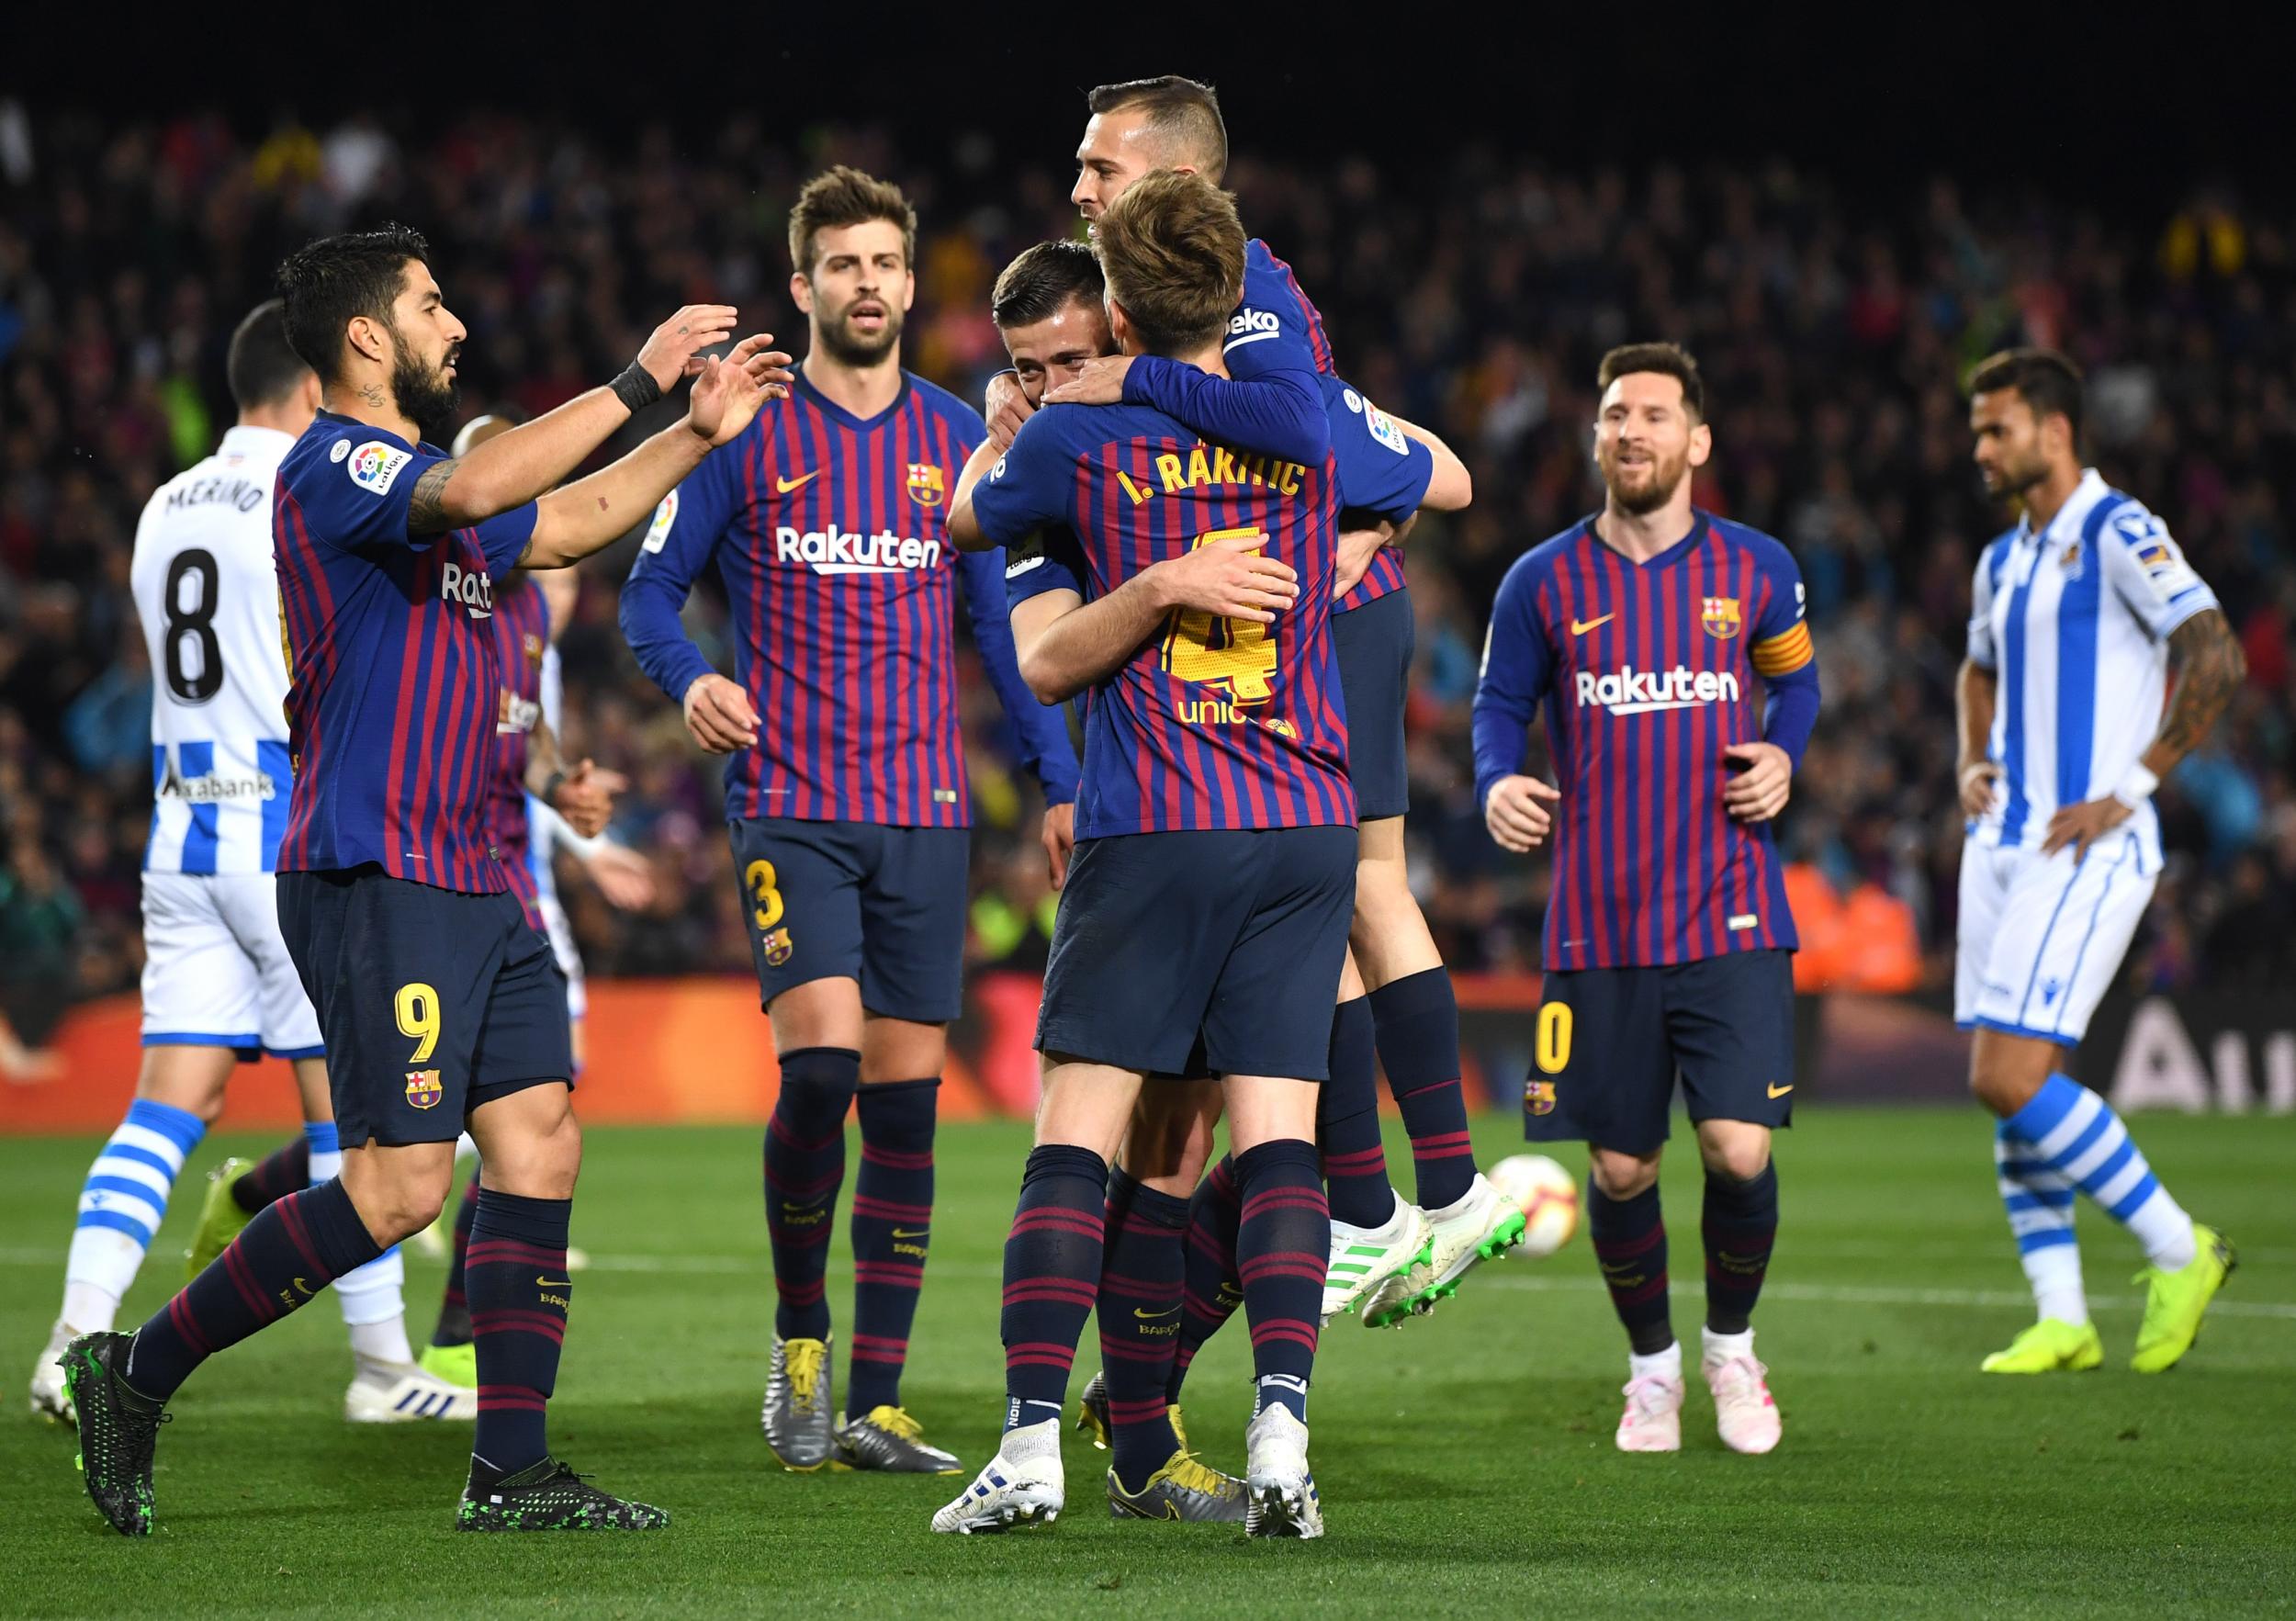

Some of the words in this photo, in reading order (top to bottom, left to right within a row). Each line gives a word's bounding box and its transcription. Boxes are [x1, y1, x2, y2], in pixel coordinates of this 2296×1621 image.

[1225, 308, 1279, 335] eko
[1116, 470, 1154, 505] I.
[776, 523, 940, 568] Rakuten
[163, 547, 223, 703] 8
[1576, 665, 1739, 707] Rakuten
[1177, 701, 1247, 725] unic
[746, 860, 784, 930] 3
[394, 983, 441, 1063] 9
